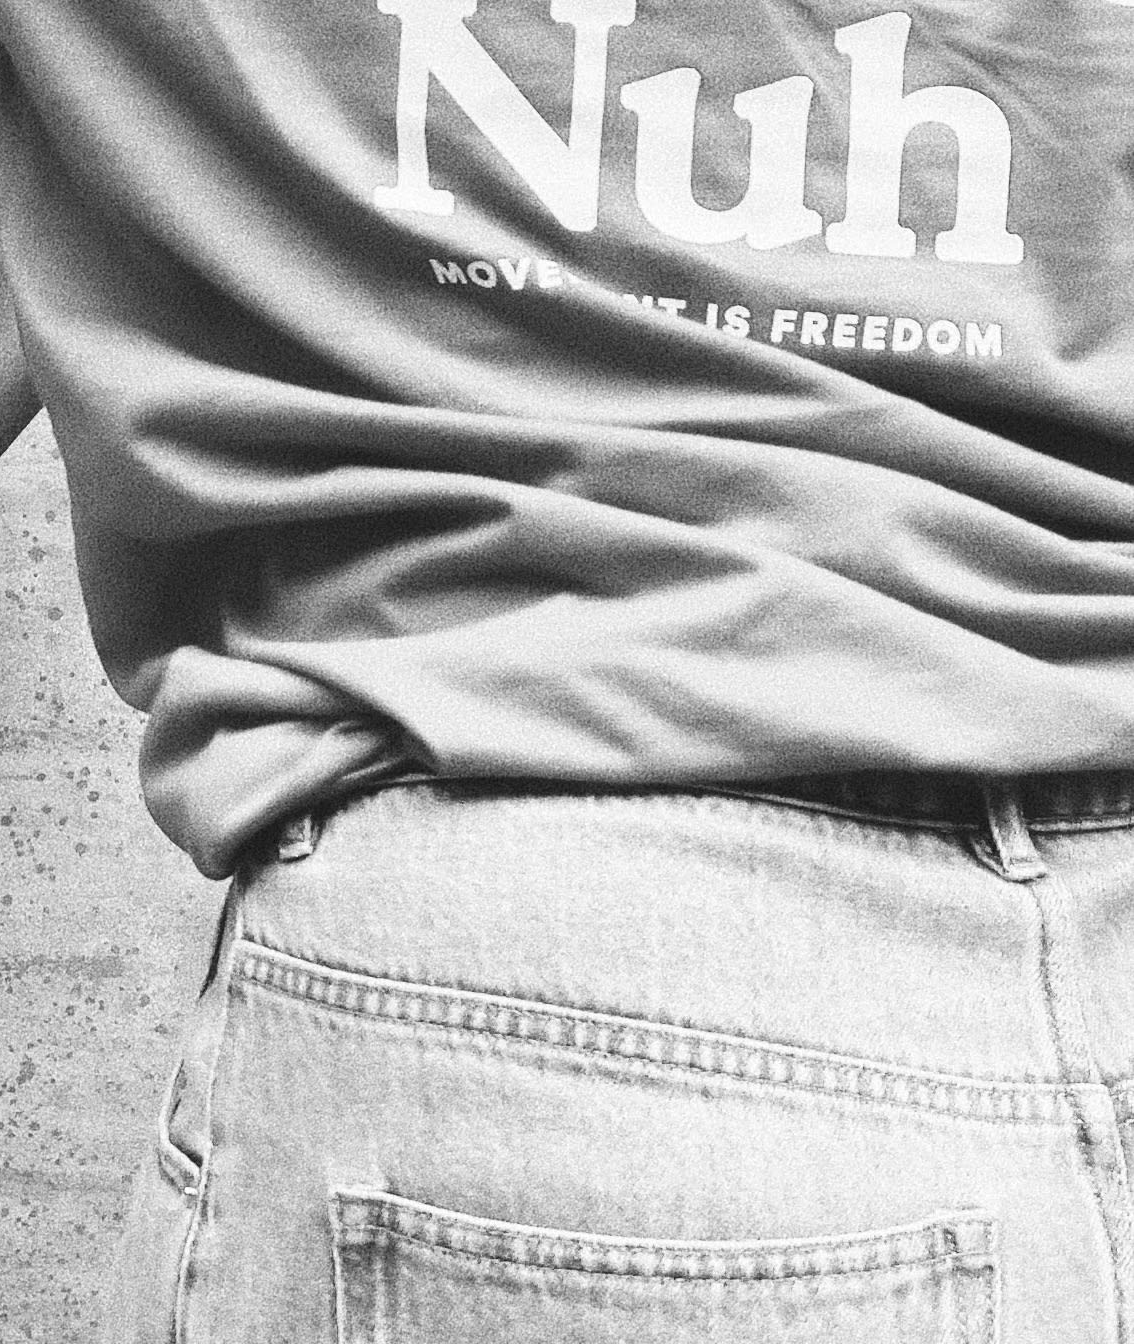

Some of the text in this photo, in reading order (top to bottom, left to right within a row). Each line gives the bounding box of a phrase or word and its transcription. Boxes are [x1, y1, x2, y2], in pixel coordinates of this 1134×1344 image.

[428, 256, 1004, 357] MOVET IS FREEDOM
